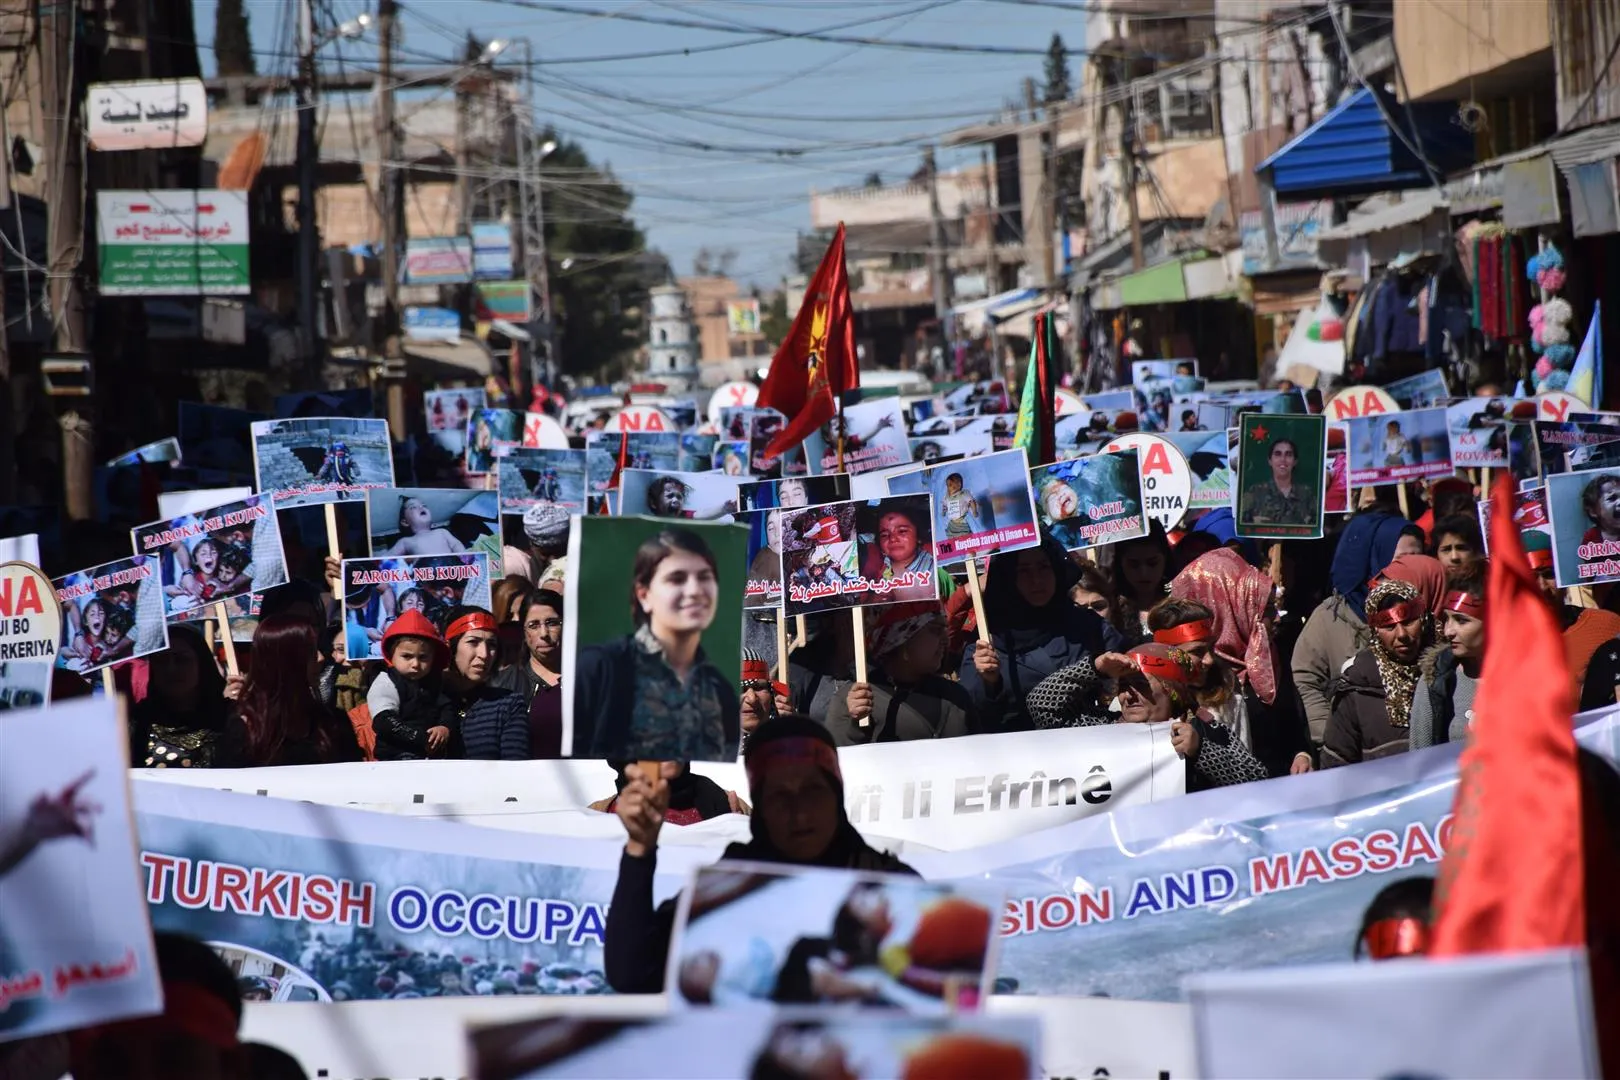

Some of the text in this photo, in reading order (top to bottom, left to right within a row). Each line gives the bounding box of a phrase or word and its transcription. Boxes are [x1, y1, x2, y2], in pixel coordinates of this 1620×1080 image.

[100, 98, 189, 133] صيدلية
[1333, 390, 1387, 420] NA
[618, 413, 664, 431] NA
[1088, 501, 1126, 521] QATIL
[144, 505, 268, 549] ZAROKA NE KUJIN
[1080, 516, 1140, 540] ERDUXAN
[57, 564, 152, 601] ROKA NE KUJIN
[352, 568, 410, 585] ZAROKA
[413, 566, 435, 582] NE
[436, 564, 481, 582] KUJIN
[789, 571, 931, 603] لا للحرب ضد الطفولة
[13, 617, 30, 635] BO
[0, 639, 55, 660] RKERIYA
[902, 780, 932, 819] li
[953, 764, 1112, 816] Efrînê
[142, 854, 607, 943] TURKISH OCCUPA
[1000, 888, 1111, 935] SION
[1127, 867, 1236, 917] AND
